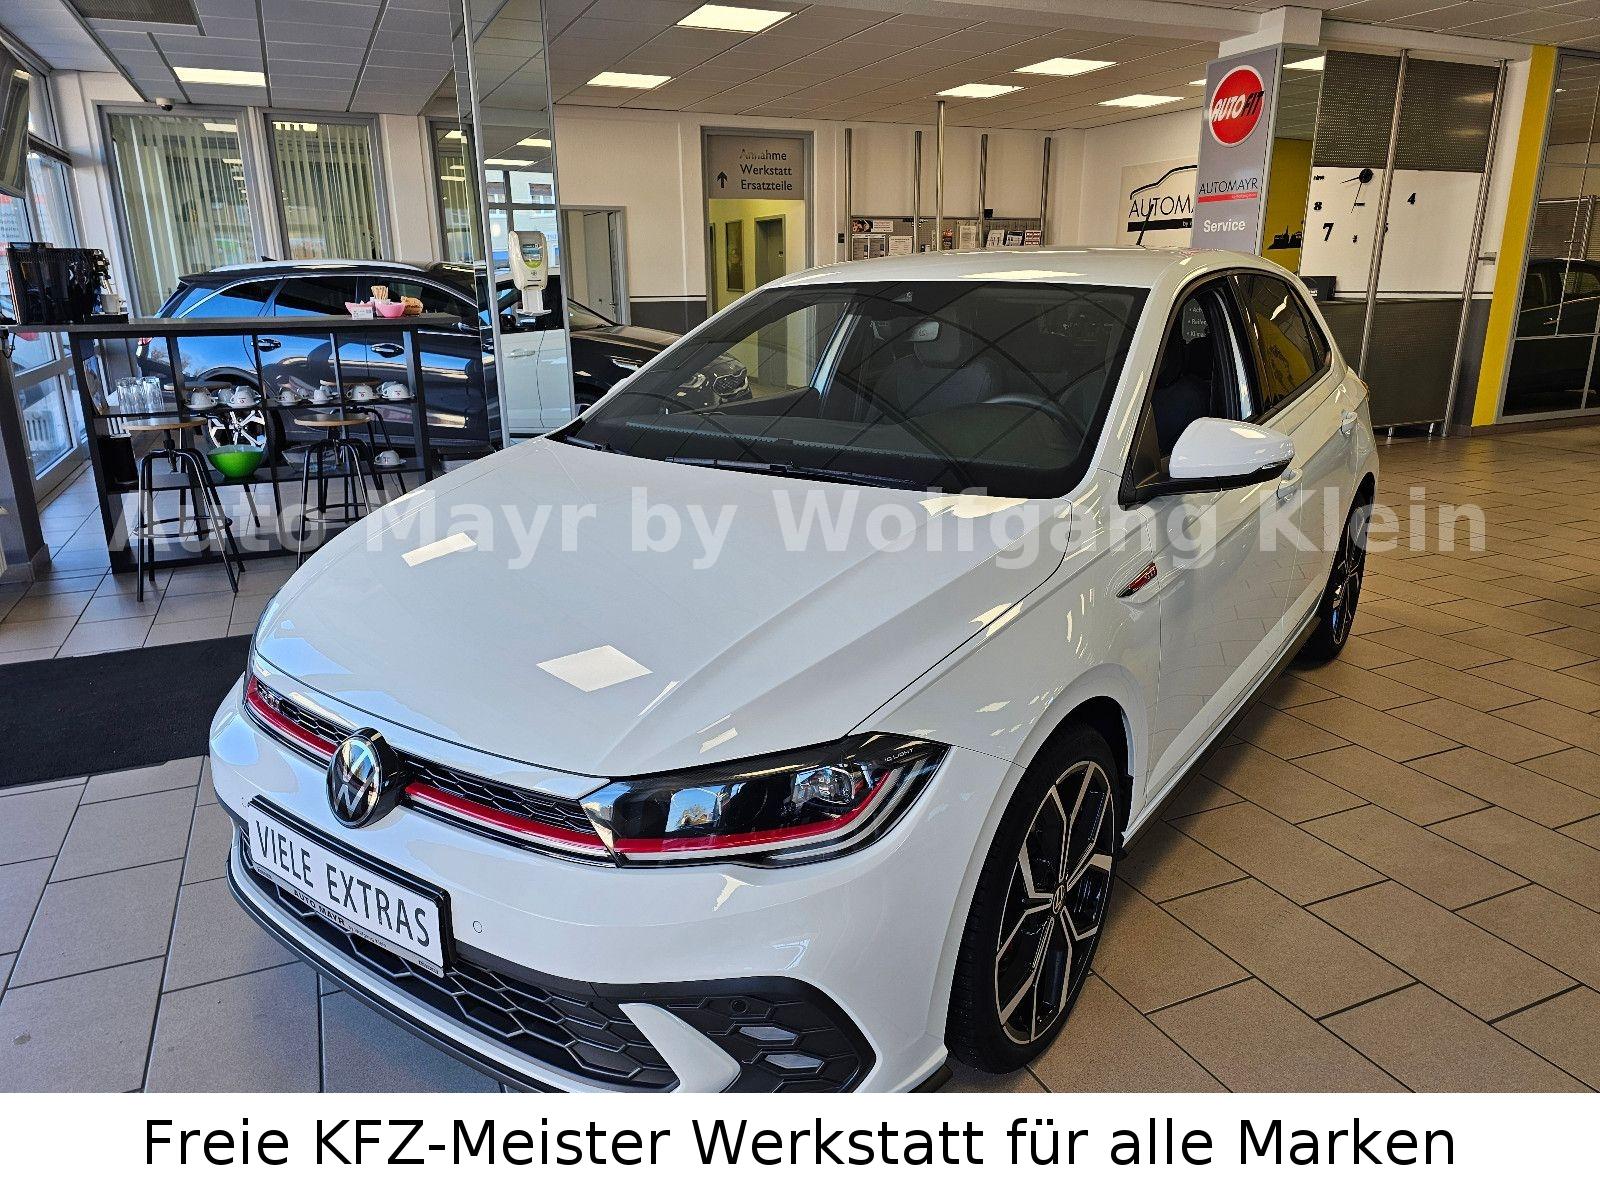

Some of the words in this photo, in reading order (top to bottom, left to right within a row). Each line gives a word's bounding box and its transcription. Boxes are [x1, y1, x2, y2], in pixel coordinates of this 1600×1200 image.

[740, 149, 787, 160] Annahme
[740, 164, 792, 176] Werkstatt
[740, 180, 793, 191] Ersatzteile
[1198, 177, 1258, 195] AUTOMAYR
[1313, 201, 1323, 210] 8
[1407, 193, 1416, 205] 4
[1203, 219, 1246, 233] Service
[1322, 222, 1334, 241] 7
[255, 819, 315, 889] VIELE
[325, 862, 431, 948] EXTRAS
[293, 888, 316, 909] AUTO
[318, 905, 346, 926] MAYR
